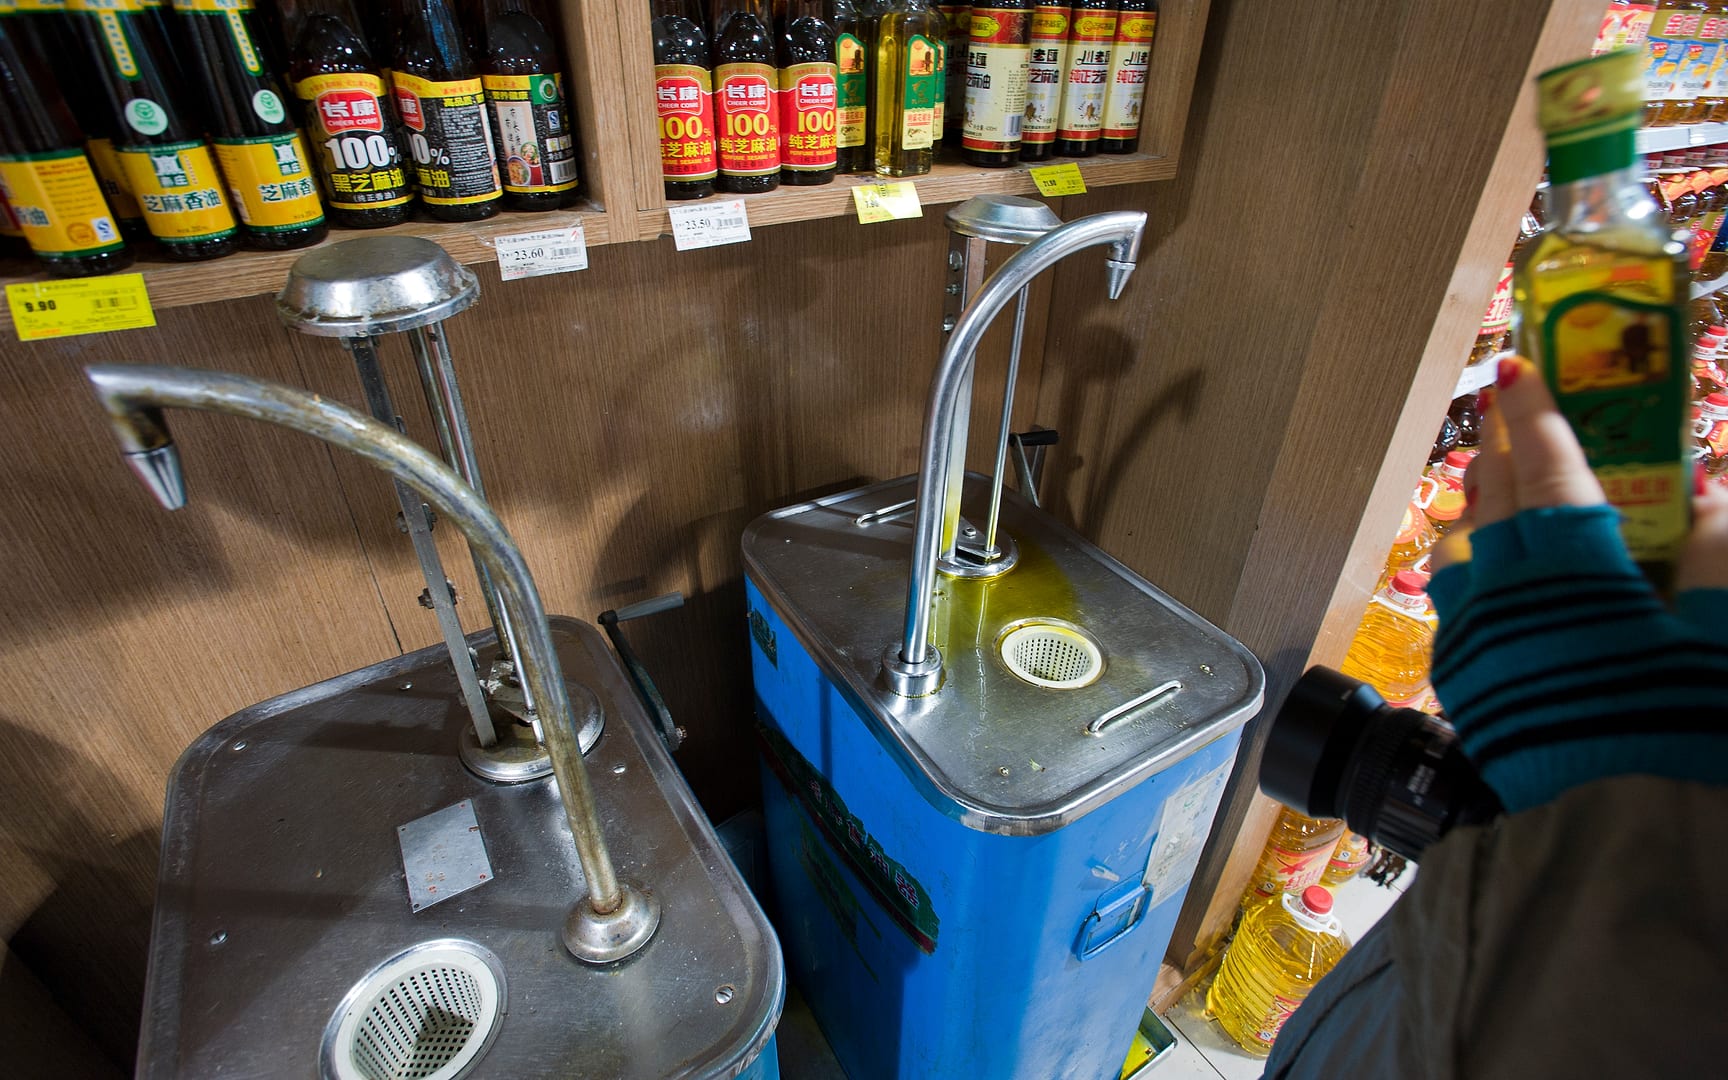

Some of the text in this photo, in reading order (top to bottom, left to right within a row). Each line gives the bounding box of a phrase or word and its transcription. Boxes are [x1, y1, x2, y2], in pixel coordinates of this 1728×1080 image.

[656, 86, 699, 101] 长康
[726, 84, 767, 99] 长康
[799, 83, 834, 97] 长康
[321, 99, 376, 118] 长康
[326, 116, 378, 127] CHEER COME
[798, 110, 834, 133] 100
[325, 134, 401, 170] 100%
[720, 137, 777, 154] 纯芝麻油
[330, 167, 405, 193] 黑芝麻油
[142, 188, 222, 214] 芝麻香油
[685, 218, 711, 231] 23.50
[513, 247, 545, 261] 23.60
